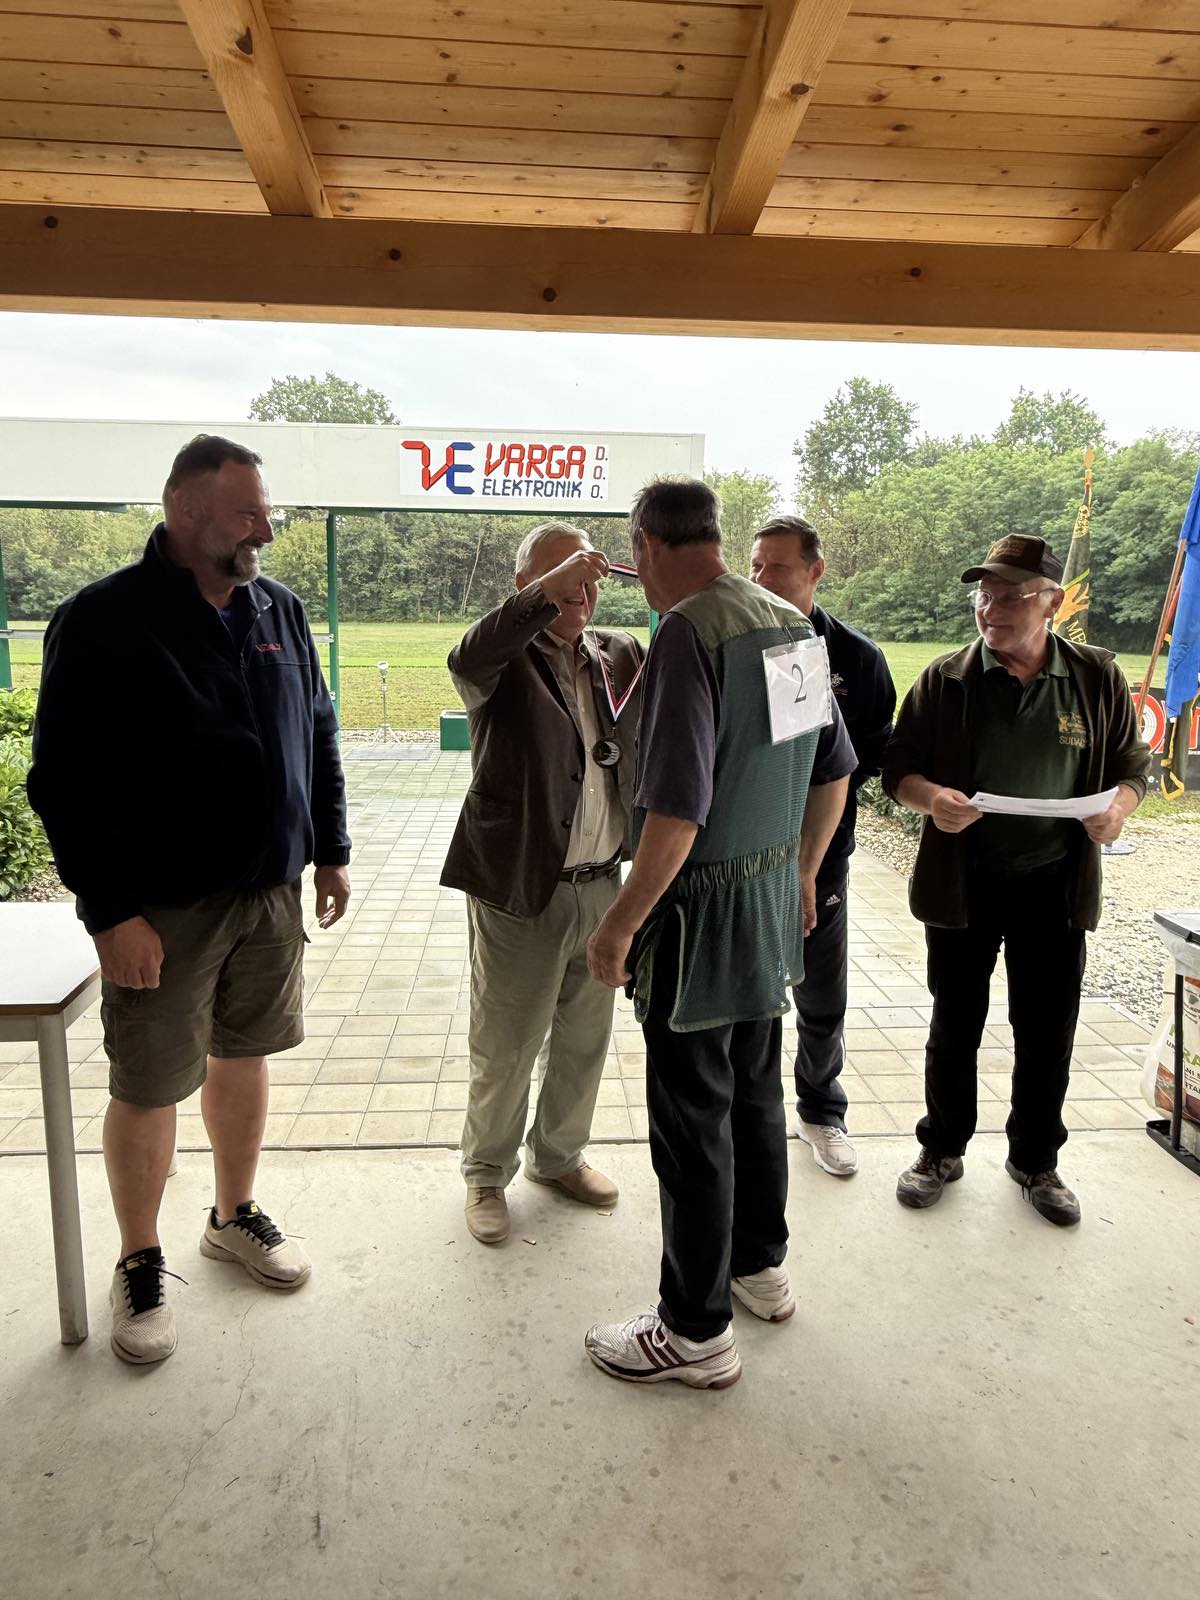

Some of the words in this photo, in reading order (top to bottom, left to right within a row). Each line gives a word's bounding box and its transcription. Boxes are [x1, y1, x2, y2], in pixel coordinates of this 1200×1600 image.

[484, 442, 587, 480] VARGA
[482, 478, 583, 498] ELEKTRONIK
[791, 663, 807, 704] 2
